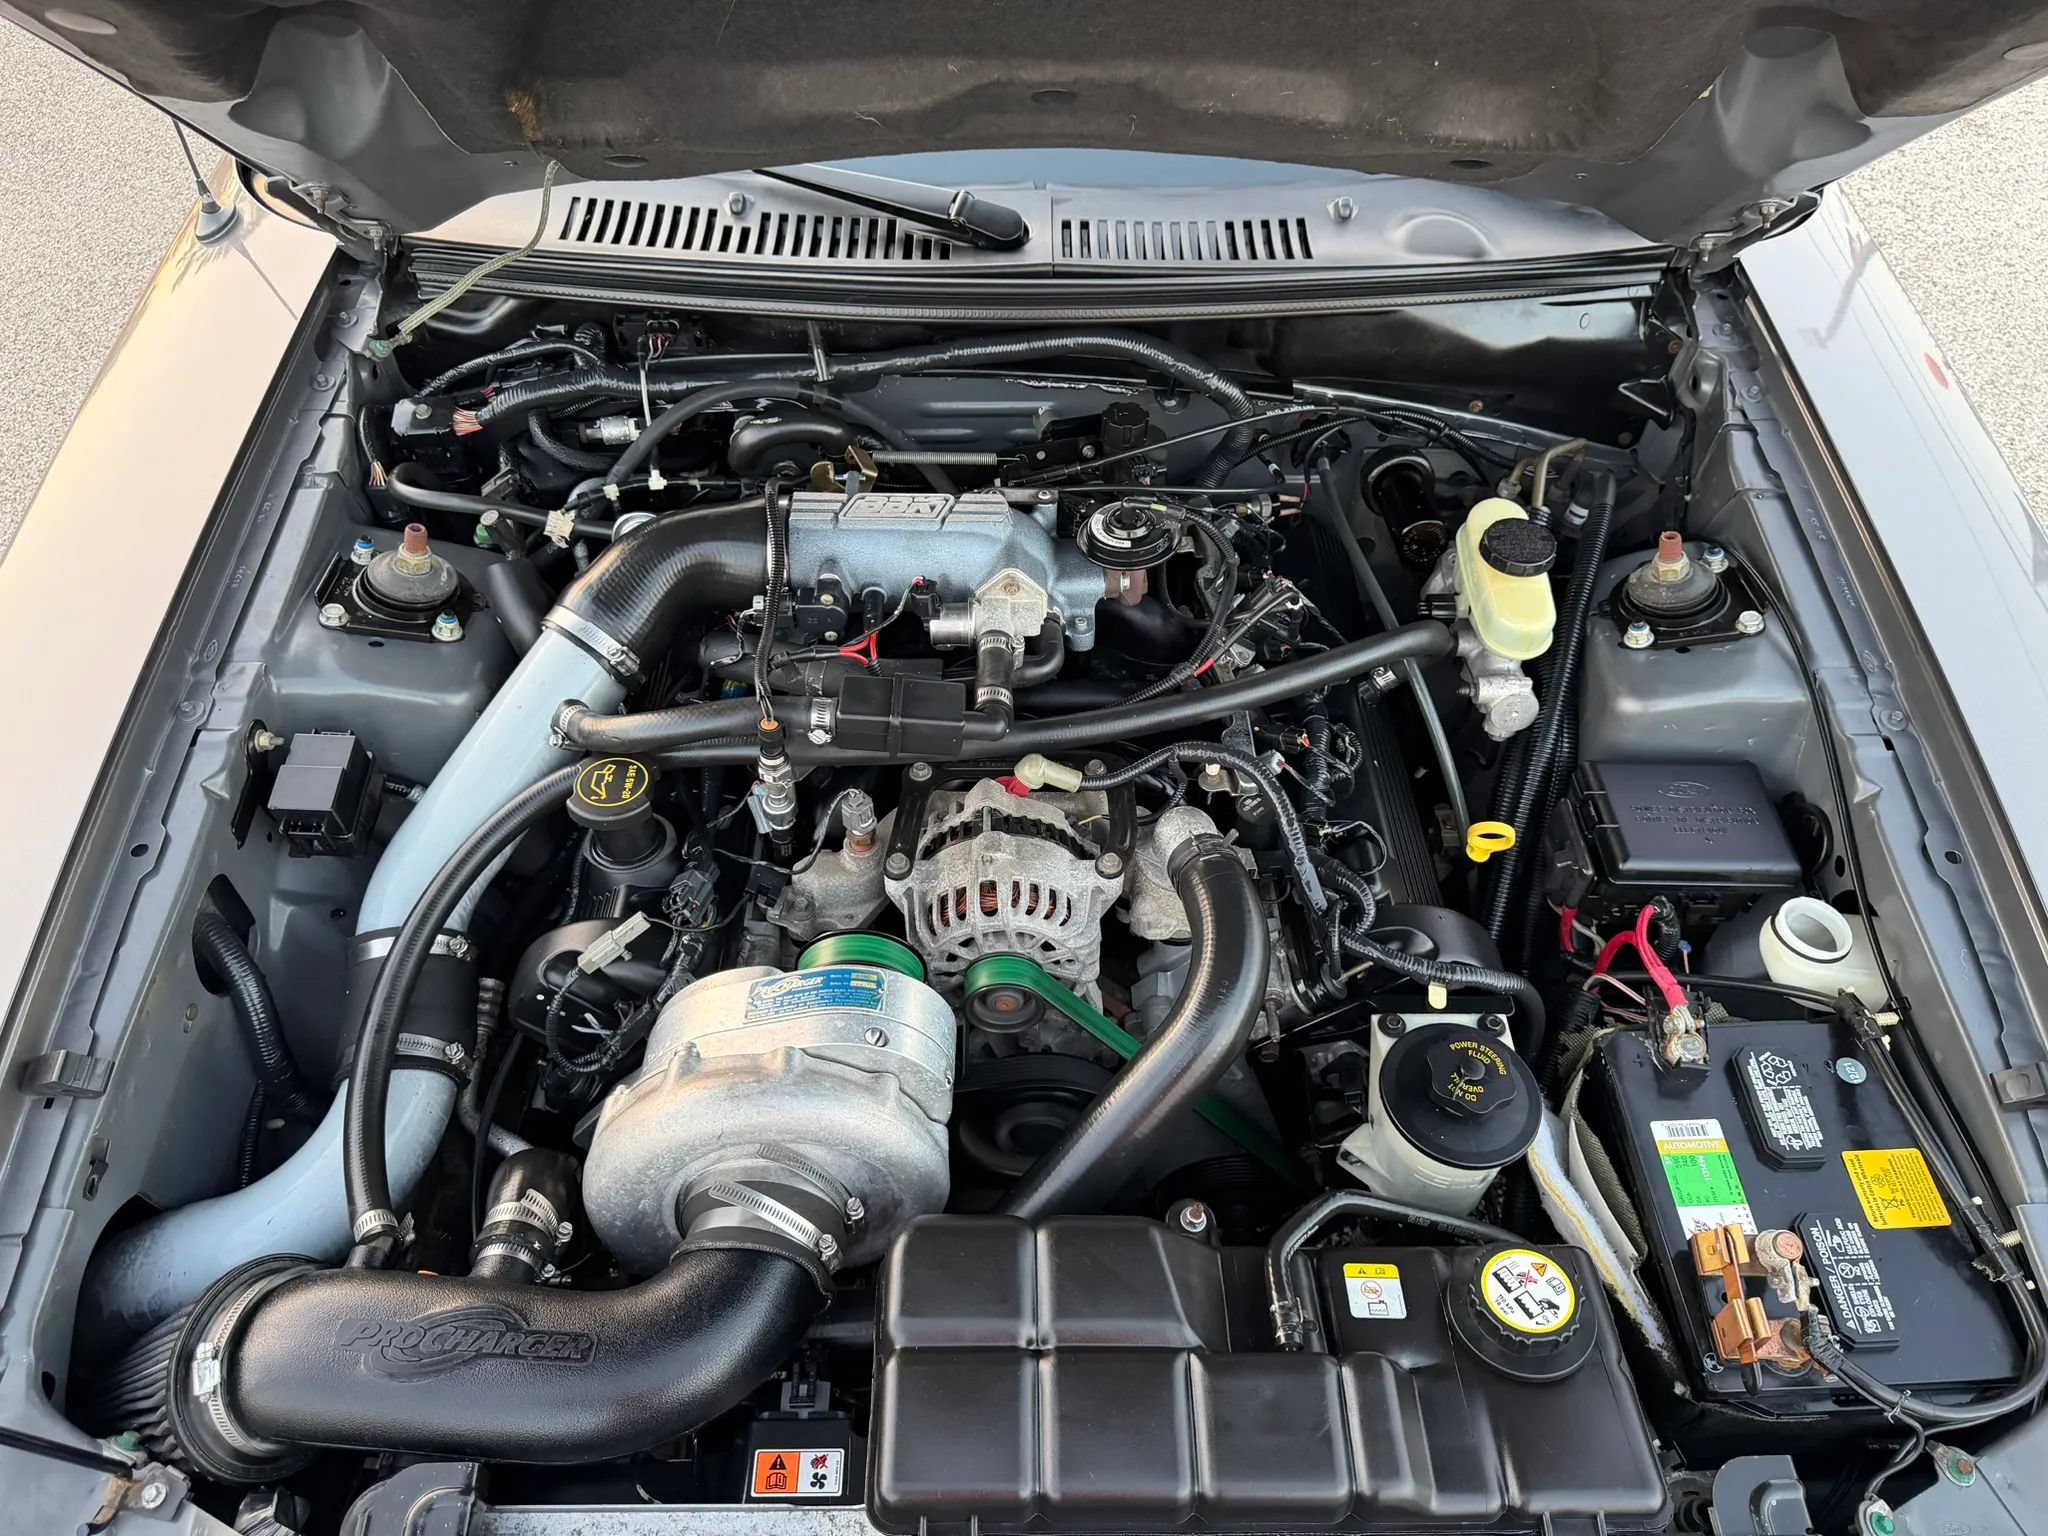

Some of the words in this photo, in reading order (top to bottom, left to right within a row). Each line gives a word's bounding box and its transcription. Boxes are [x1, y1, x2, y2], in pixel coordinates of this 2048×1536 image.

[1449, 1041, 1478, 1051] POWER
[1480, 1045, 1507, 1075] STEERING
[1468, 1050, 1491, 1064] FLUID
[1465, 1093, 1477, 1101] DO
[1663, 1141, 1721, 1150] AUTOMOTIVE
[1810, 1228, 1831, 1265] POISON
[1829, 1275, 1853, 1319] DANGER
[341, 1322, 592, 1359] PROCHARGER
